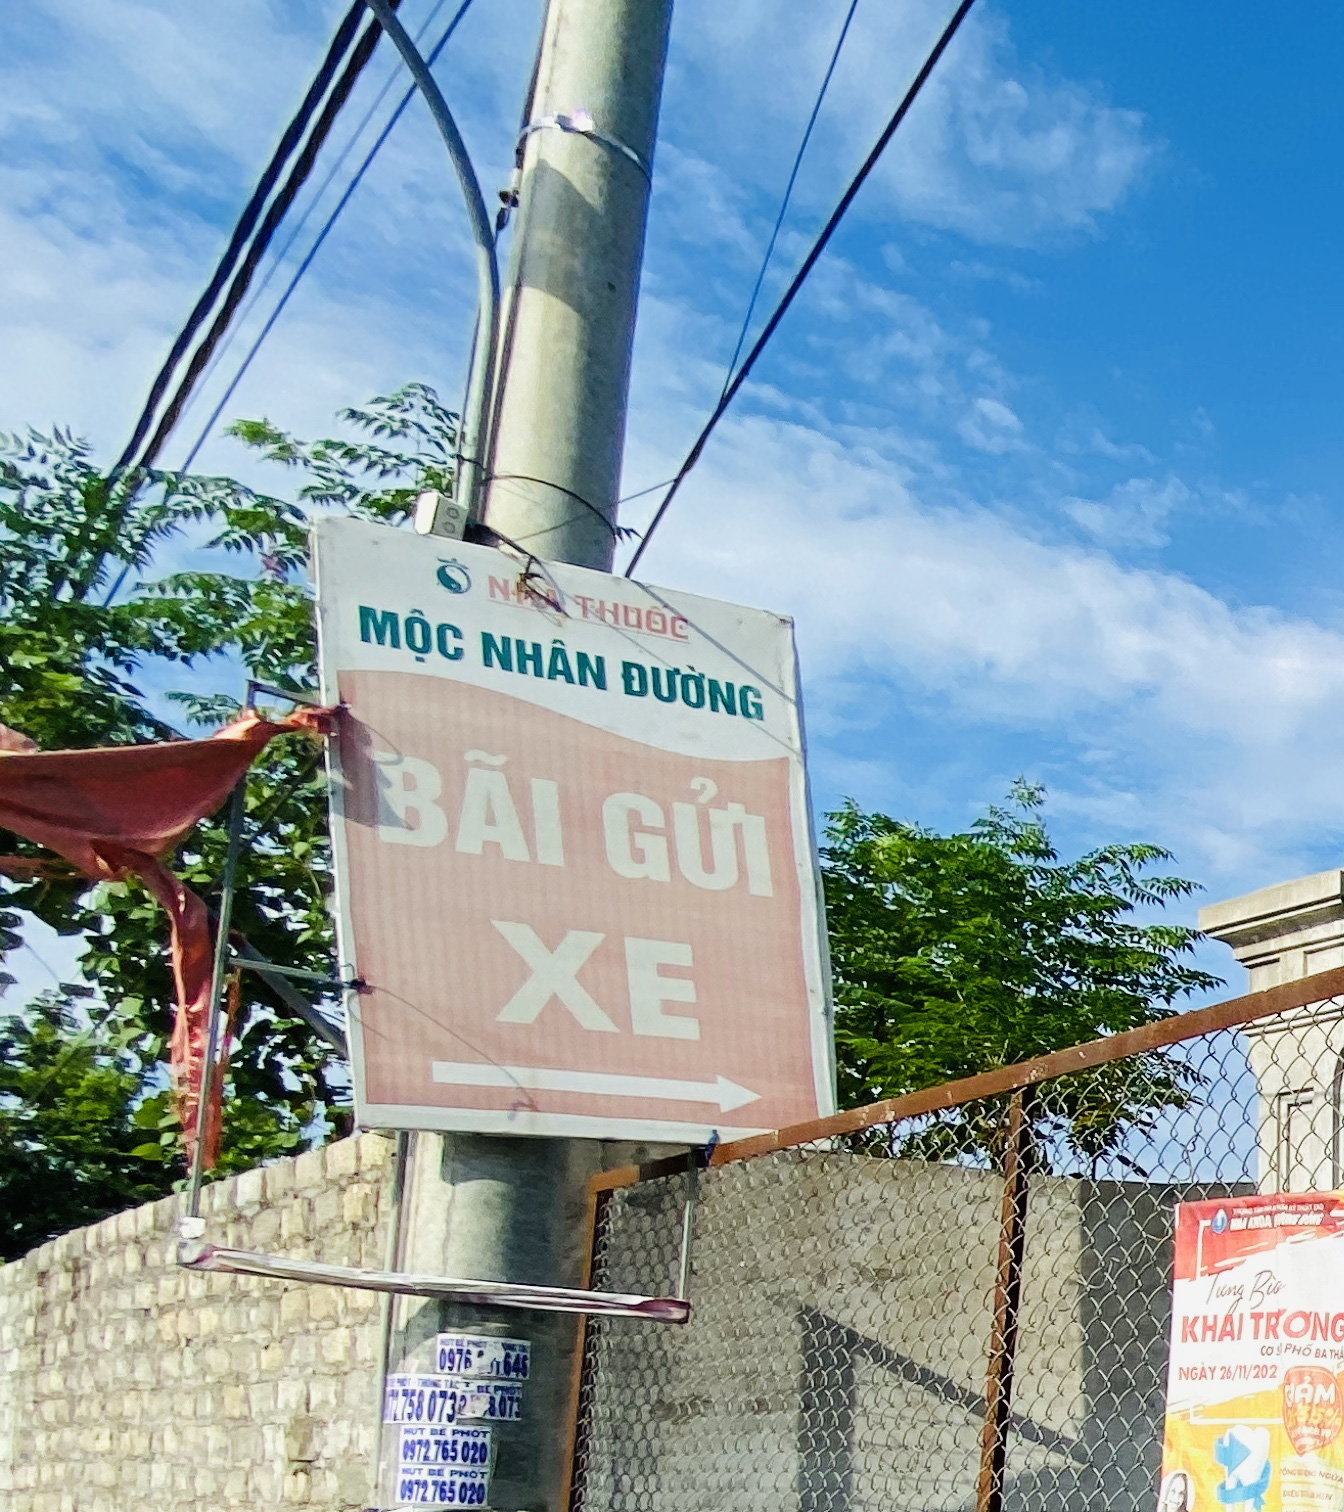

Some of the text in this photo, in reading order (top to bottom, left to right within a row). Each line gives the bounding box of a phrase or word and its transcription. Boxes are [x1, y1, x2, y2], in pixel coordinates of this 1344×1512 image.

[358, 604, 765, 722] MỘC NHÂN ĐƯỜNG
[375, 748, 775, 898] BÃI GỬI
[489, 918, 701, 1041] XE
[1178, 1361, 1278, 1381] NGÀY 26/11/202
